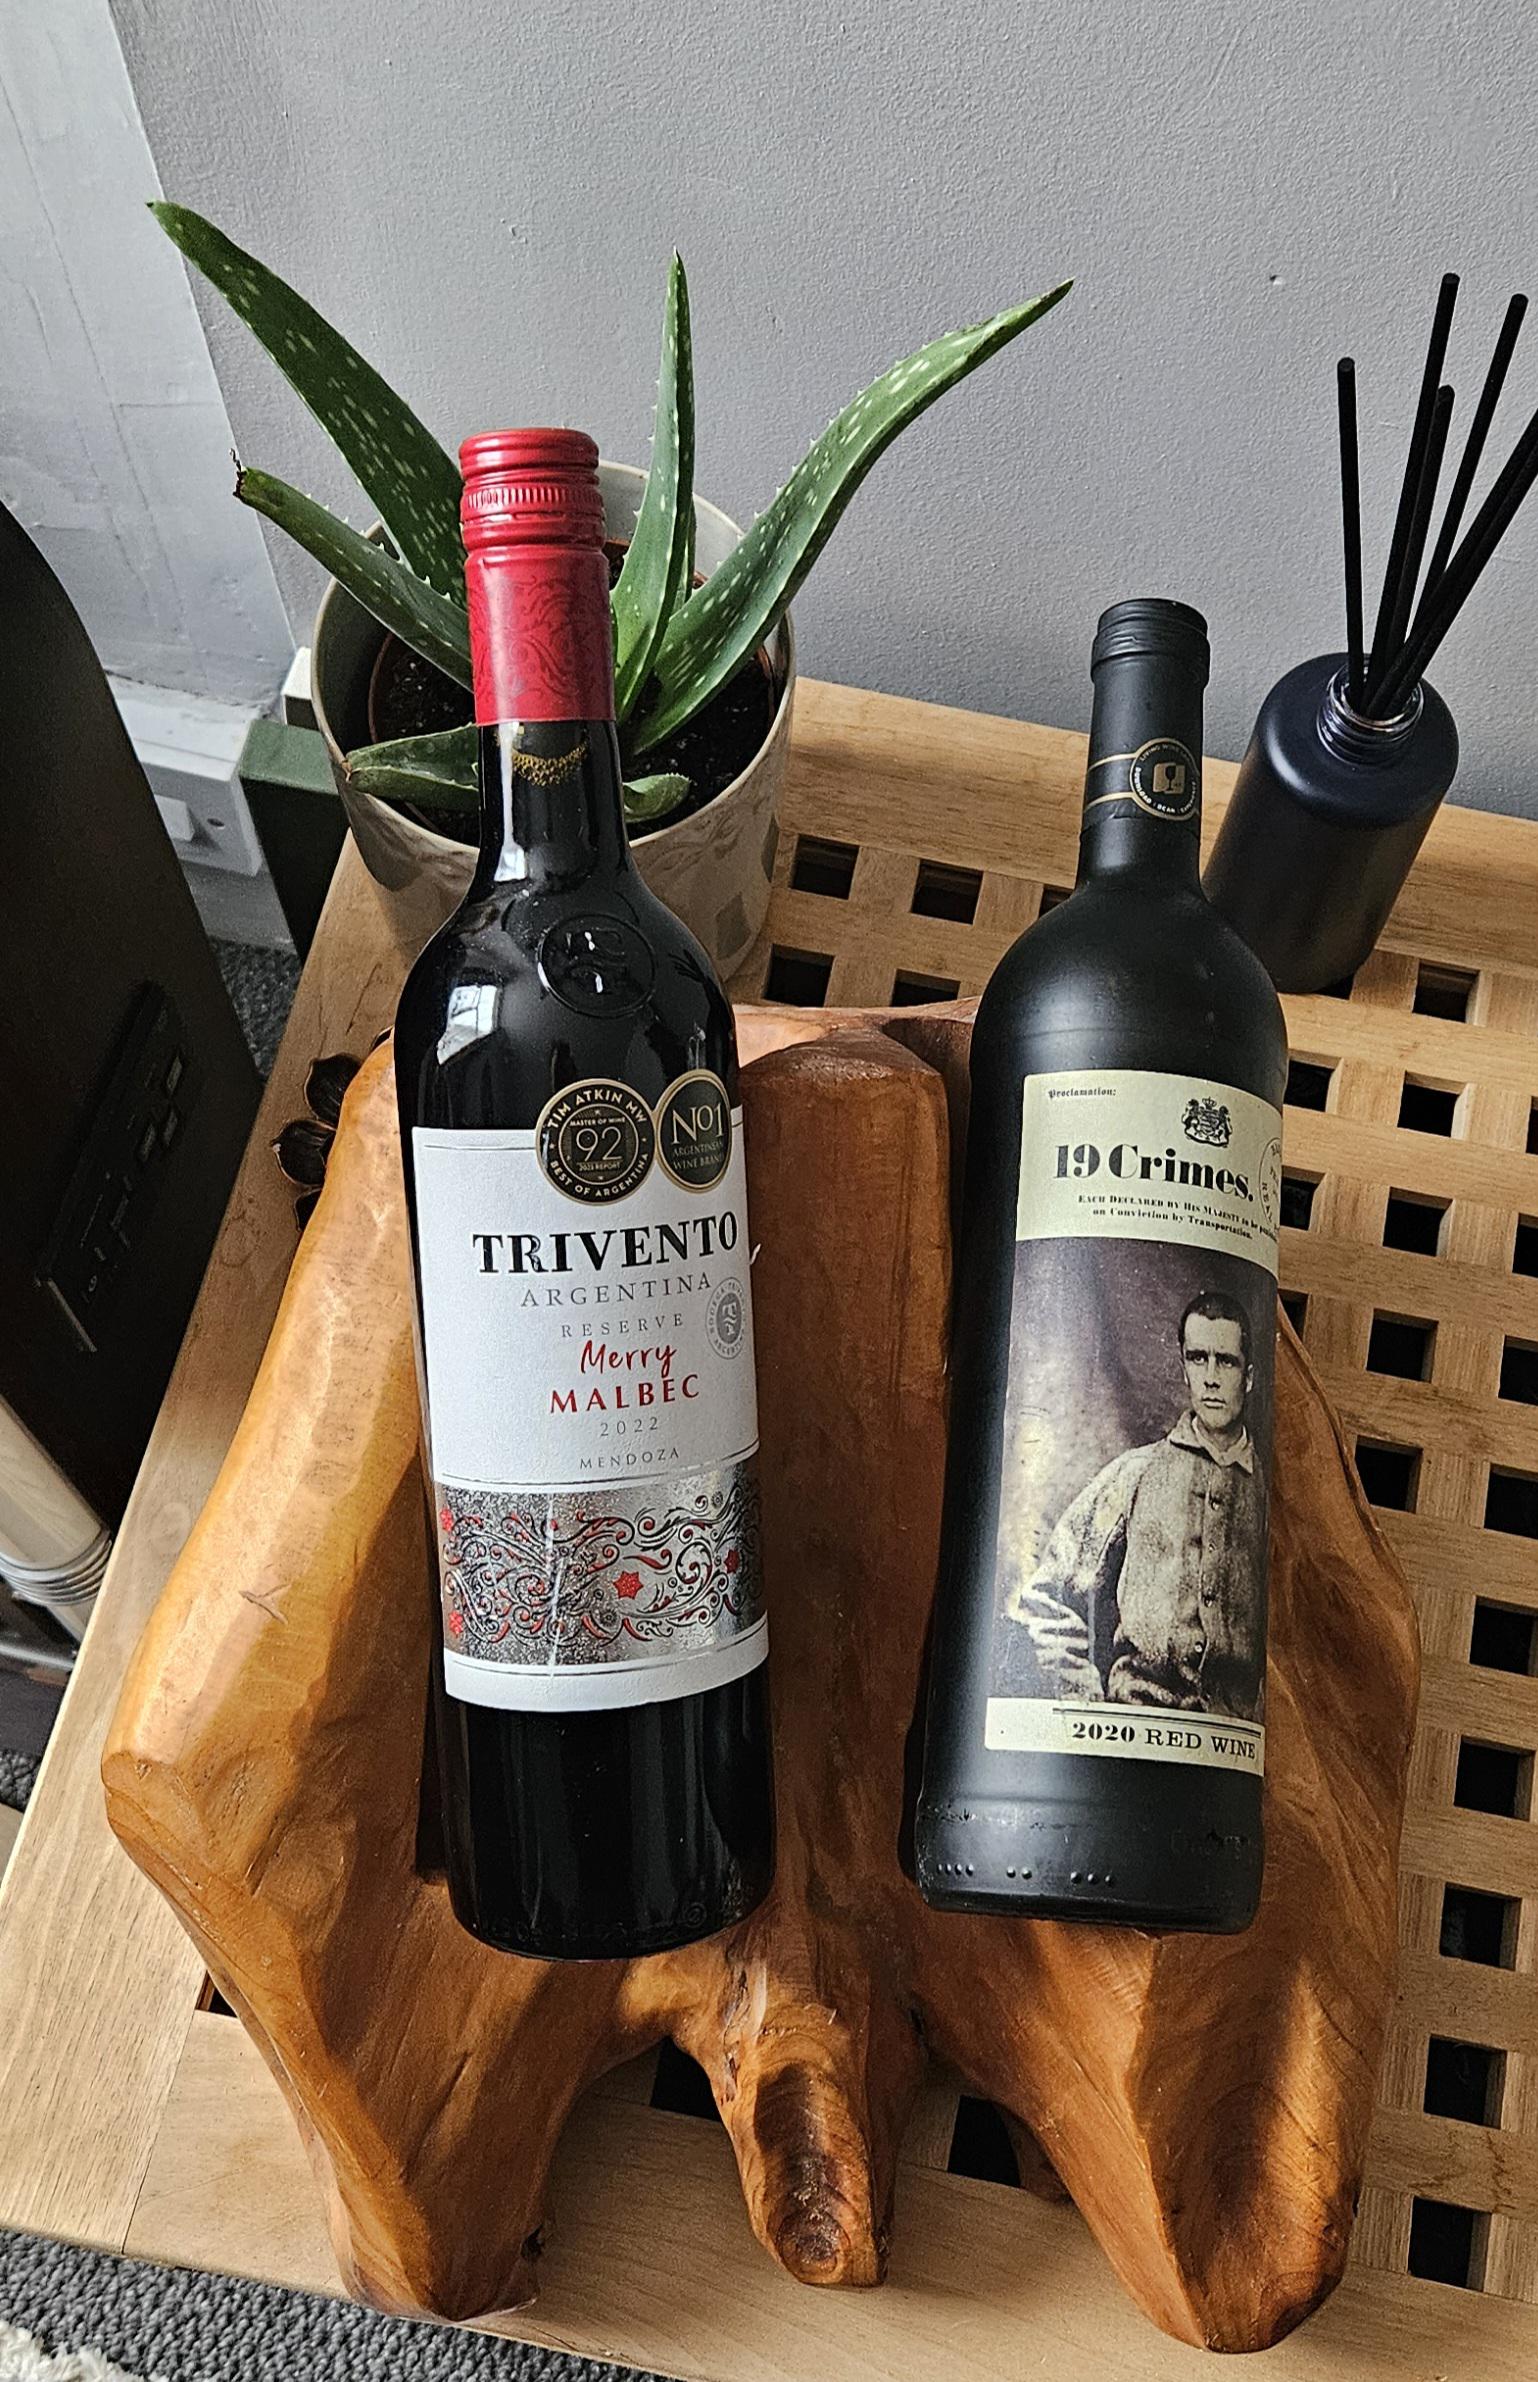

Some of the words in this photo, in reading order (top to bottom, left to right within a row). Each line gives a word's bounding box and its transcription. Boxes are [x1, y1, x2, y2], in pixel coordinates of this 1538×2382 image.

[547, 1102, 572, 1129] TIM
[575, 1088, 623, 1105] ATKIN
[625, 1100, 648, 1122] MW
[569, 1119, 596, 1127] MASTER
[576, 1126, 622, 1162] 92
[550, 1160, 573, 1186] BEST
[574, 1184, 591, 1196] OF
[595, 1153, 649, 1197] ARGENTINA
[672, 1158, 698, 1170] WINE
[1053, 1143, 1101, 1179] 19
[1108, 1143, 1254, 1202] Crimes.
[472, 1210, 739, 1274] TRIVENTO
[520, 1271, 711, 1307] ARGENTINA
[560, 1312, 685, 1338] RESERVE
[580, 1339, 677, 1379] Merry
[550, 1373, 700, 1414] MALBEC
[600, 1416, 660, 1437] 2022
[579, 1447, 680, 1470] MENDOZA
[1072, 1721, 1136, 1743] 2020
[1144, 1727, 1202, 1750] RED
[1210, 1735, 1256, 1760] WINE
